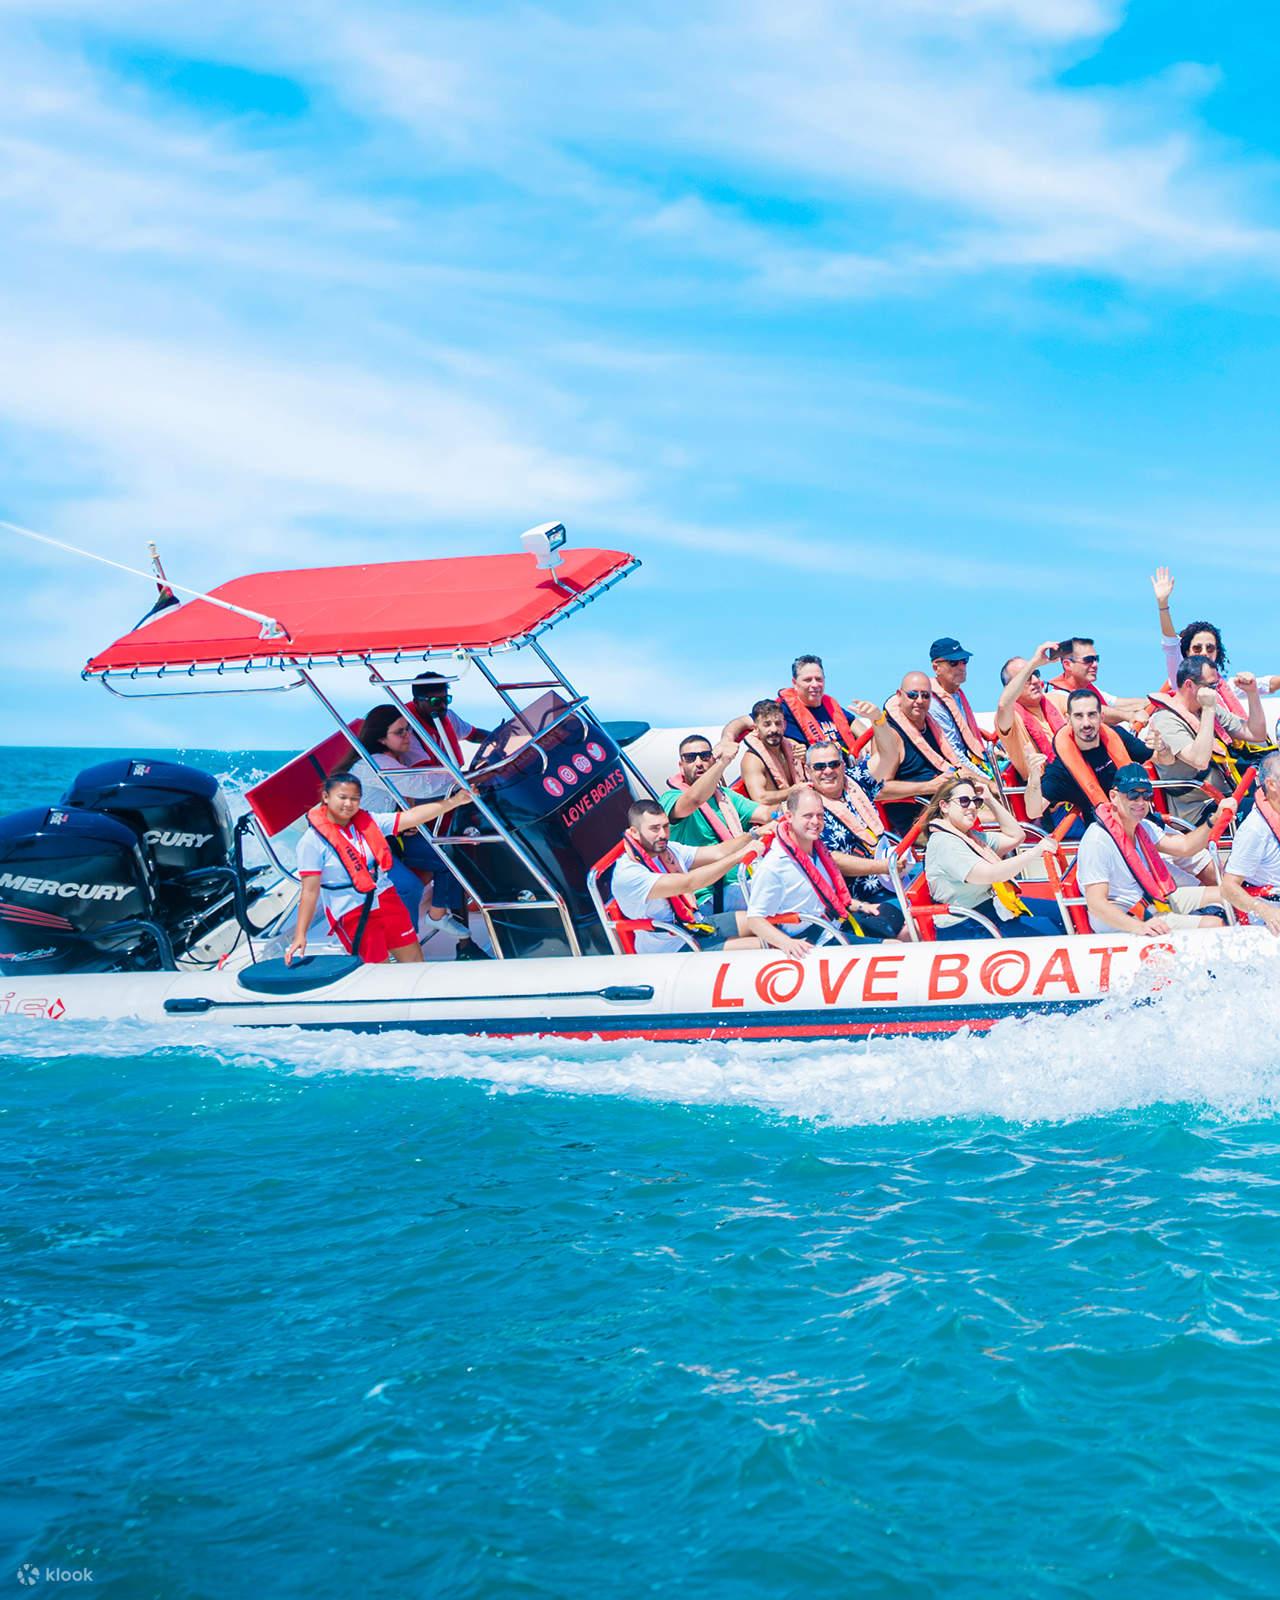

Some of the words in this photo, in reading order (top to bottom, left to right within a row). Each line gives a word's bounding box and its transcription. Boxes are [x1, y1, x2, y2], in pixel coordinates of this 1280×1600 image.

[561, 795, 593, 828] LOVE
[590, 769, 625, 804] BOATS
[0, 873, 136, 901] MERCURY
[712, 955, 906, 1008] LOVE
